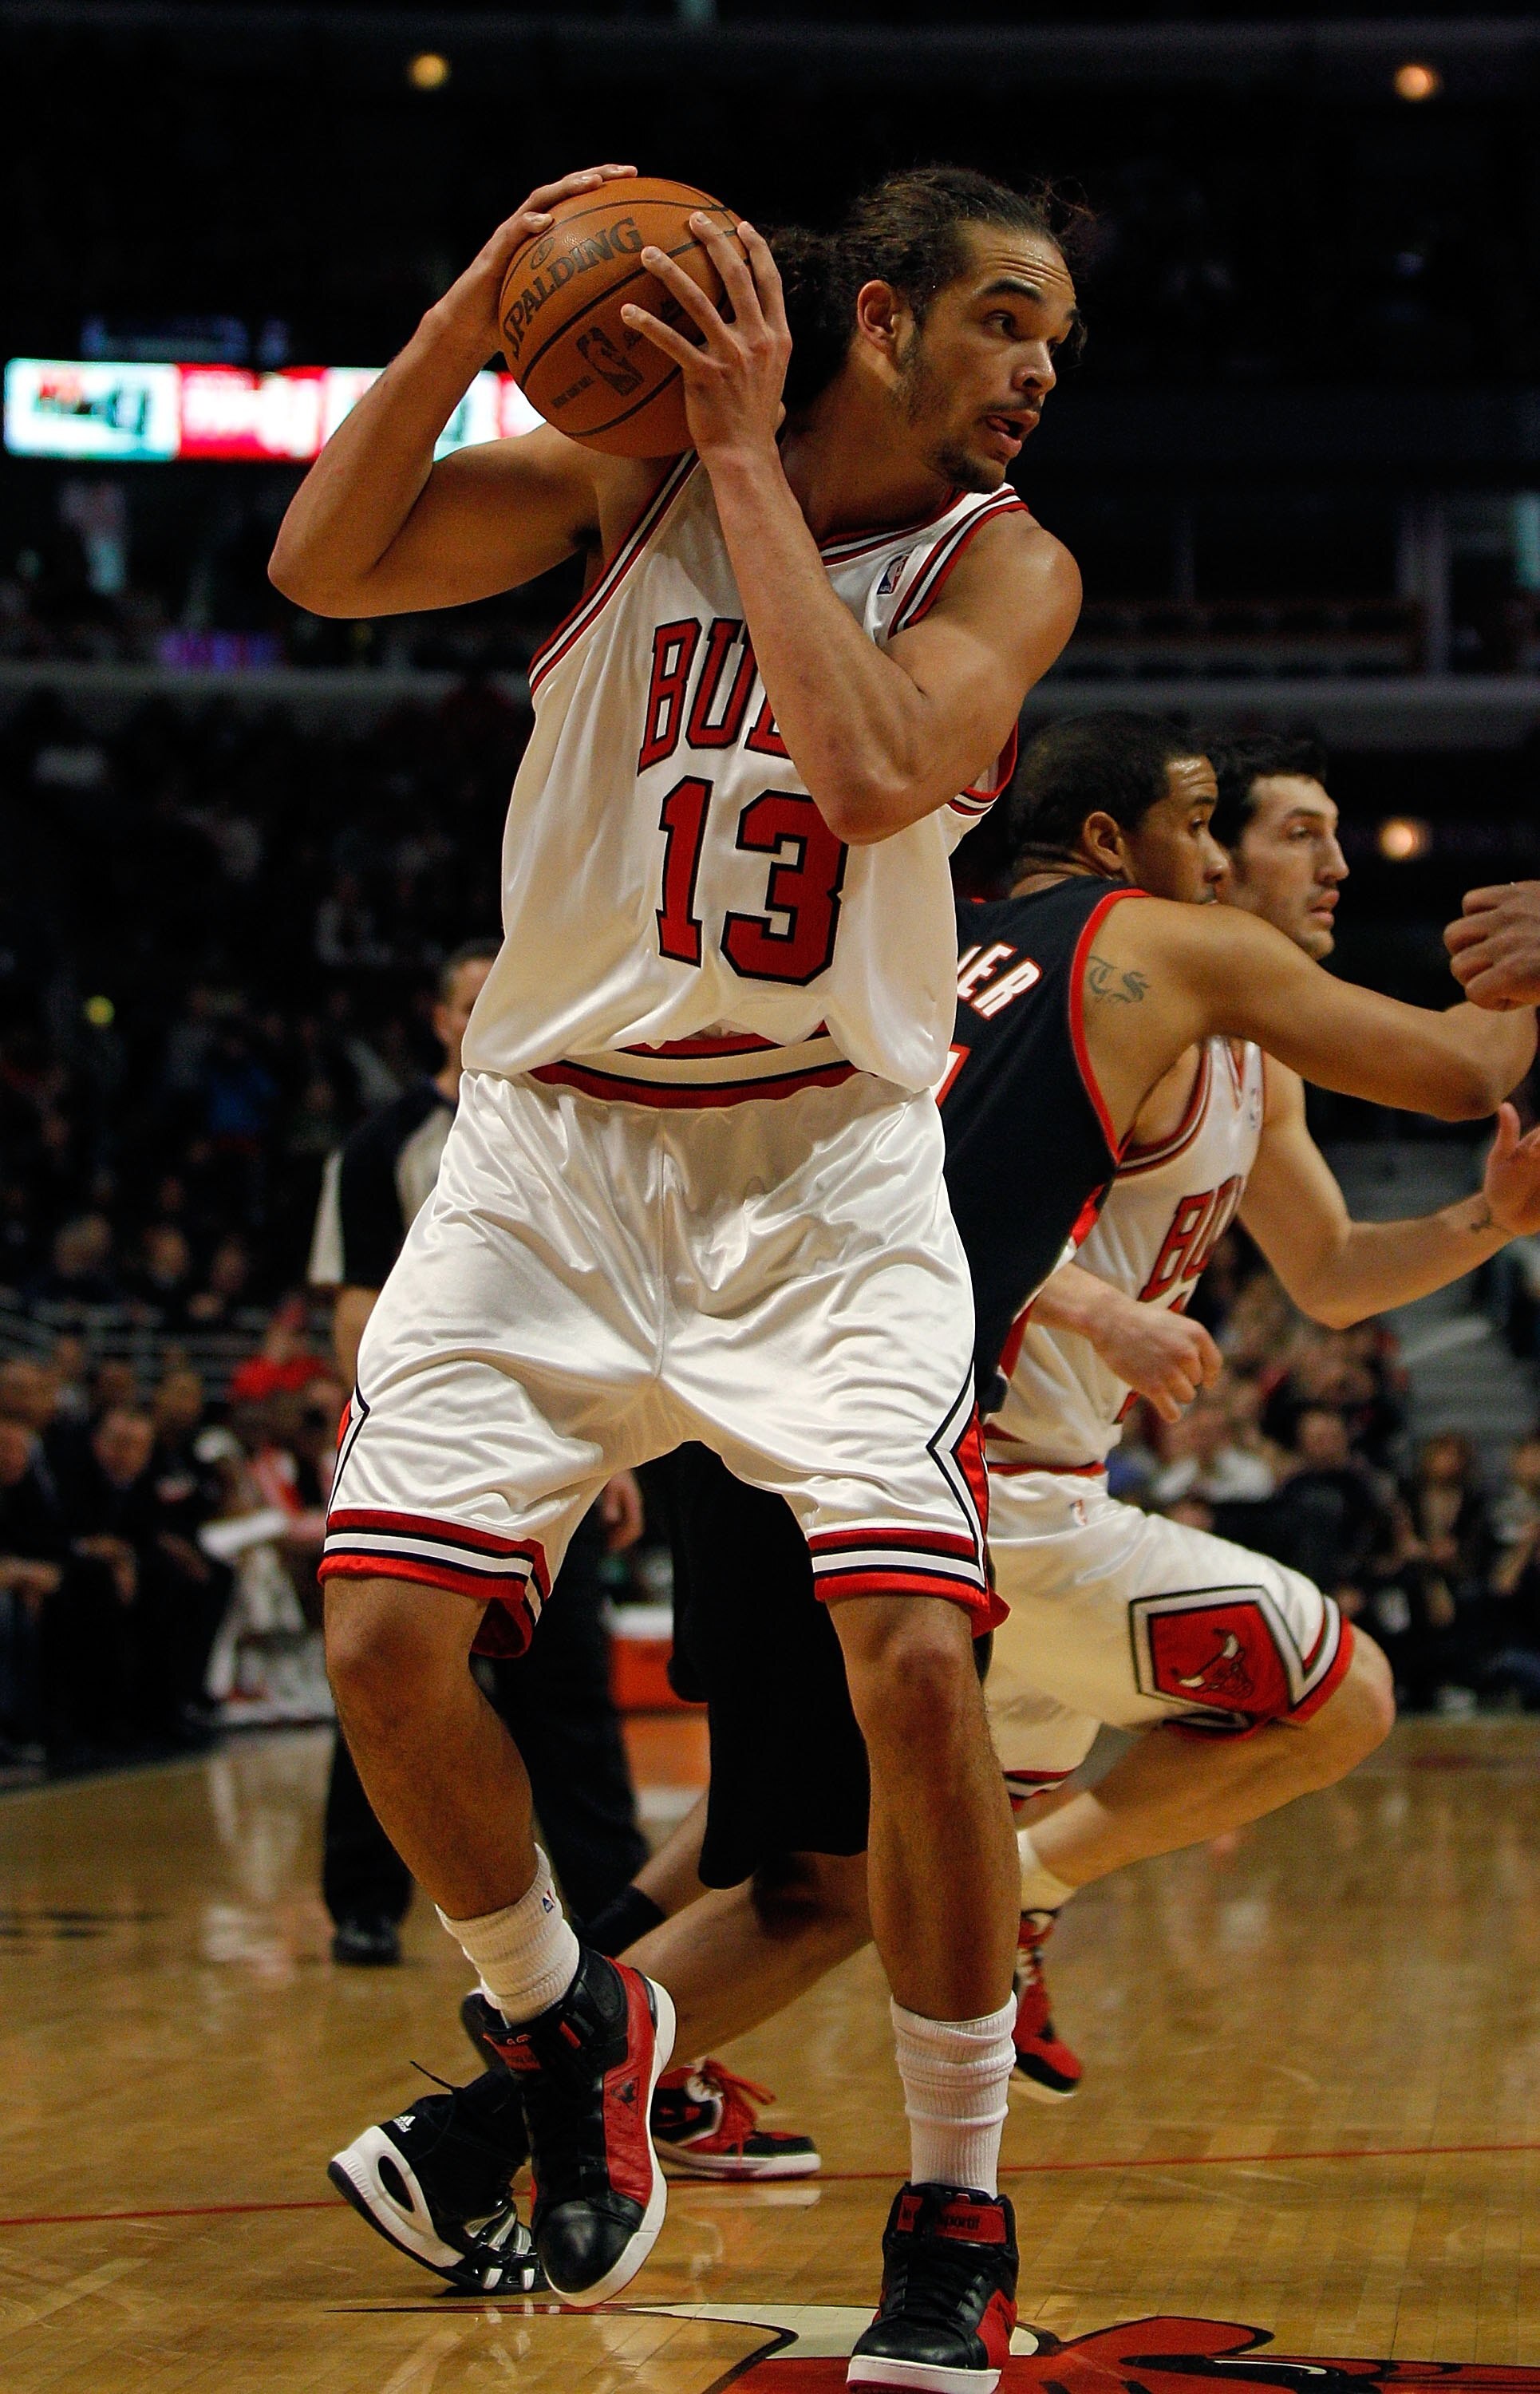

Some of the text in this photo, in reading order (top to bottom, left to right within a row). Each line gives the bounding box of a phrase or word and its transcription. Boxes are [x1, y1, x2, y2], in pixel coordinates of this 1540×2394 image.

[503, 218, 643, 360] SPALDING
[654, 775, 849, 986] 13
[957, 939, 1042, 1021] ER
